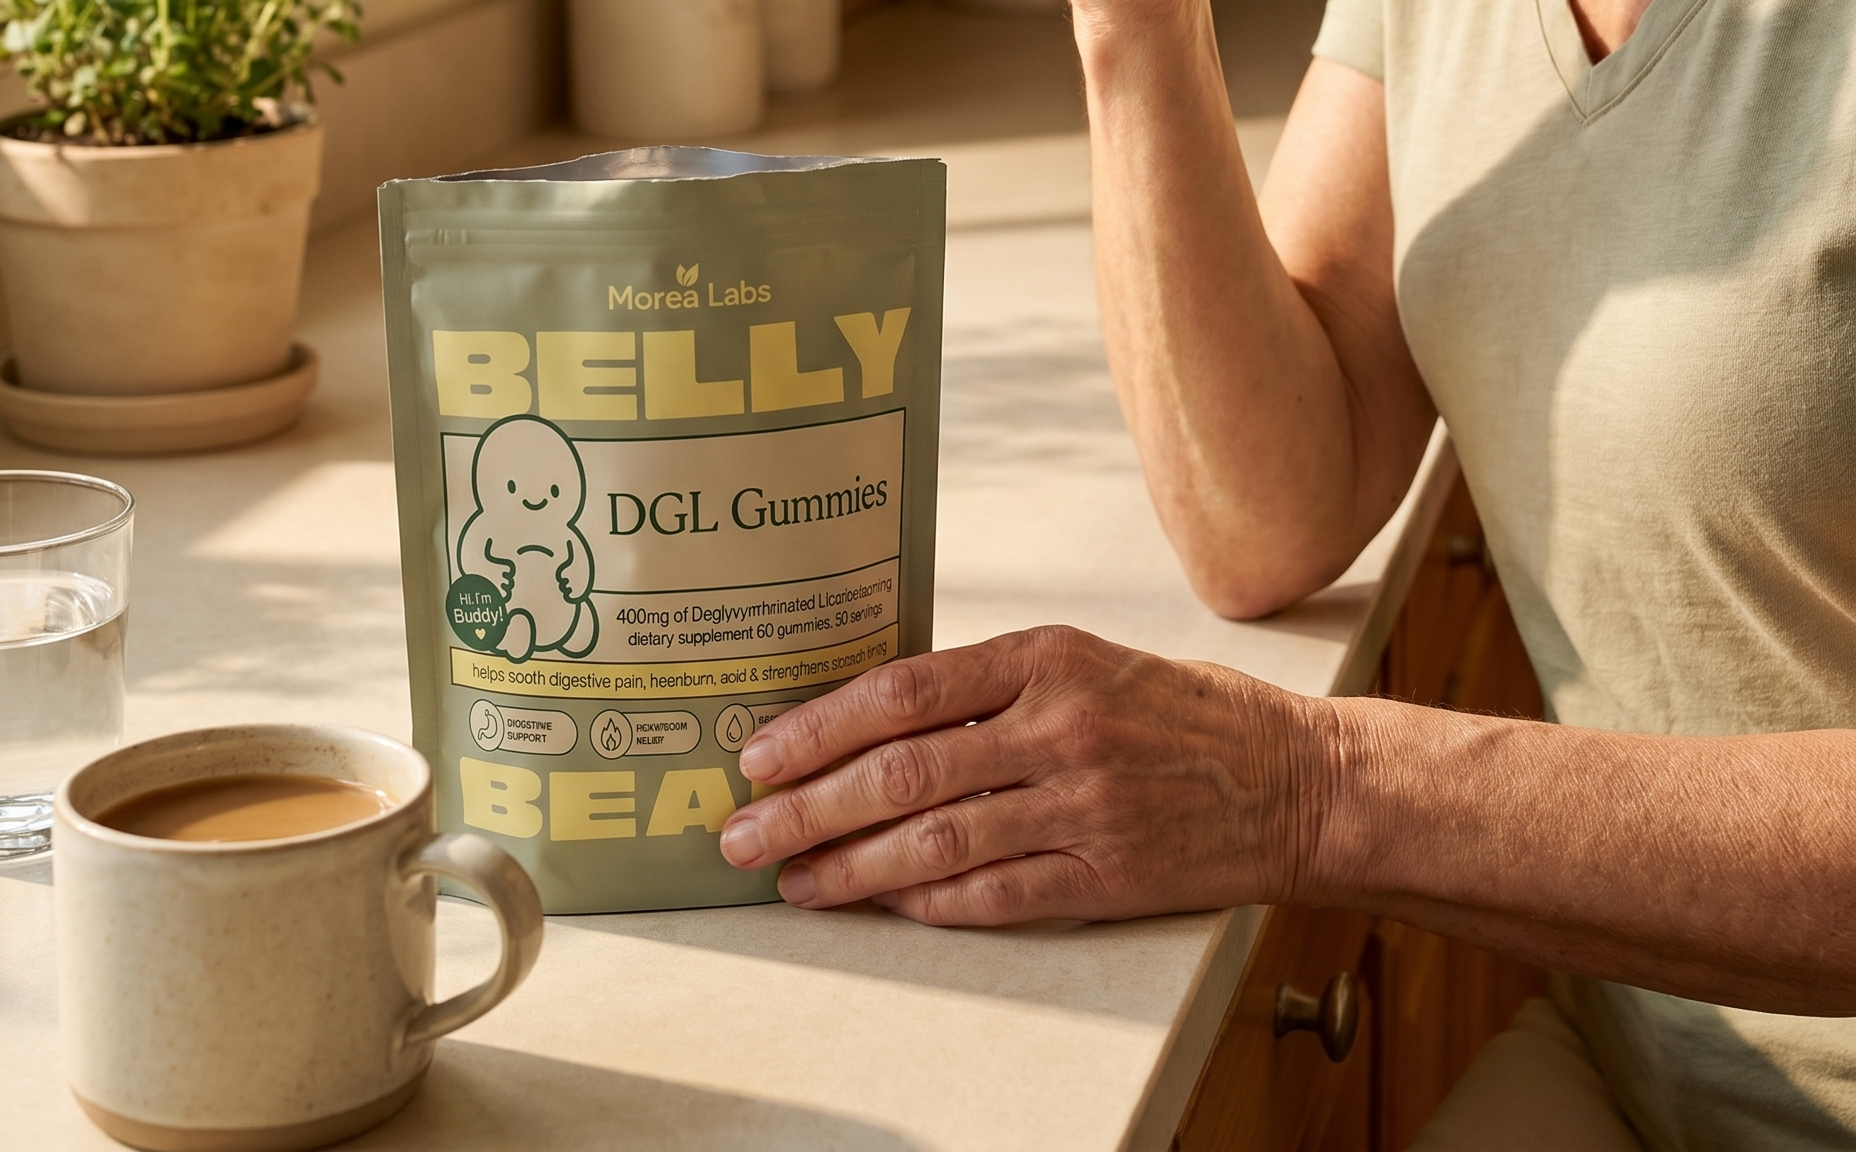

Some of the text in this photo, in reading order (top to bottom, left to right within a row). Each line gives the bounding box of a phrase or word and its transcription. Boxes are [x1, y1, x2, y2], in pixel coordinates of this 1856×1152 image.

[608, 280, 772, 310] Morea Labs
[432, 307, 912, 421] BELLY
[607, 475, 888, 535] DGL Gummies
[453, 606, 504, 627] Buddy!
[616, 608, 669, 627] 400mg
[673, 606, 688, 623] of
[628, 602, 883, 648] dietary supplement 60 gummies. 50 servings
[472, 663, 505, 682] helps
[508, 670, 546, 686] sooth
[549, 672, 611, 691] digestive
[614, 673, 647, 692] pain,
[749, 667, 759, 682] &
[507, 731, 547, 743] SUPPORT
[459, 756, 785, 842] BEA
